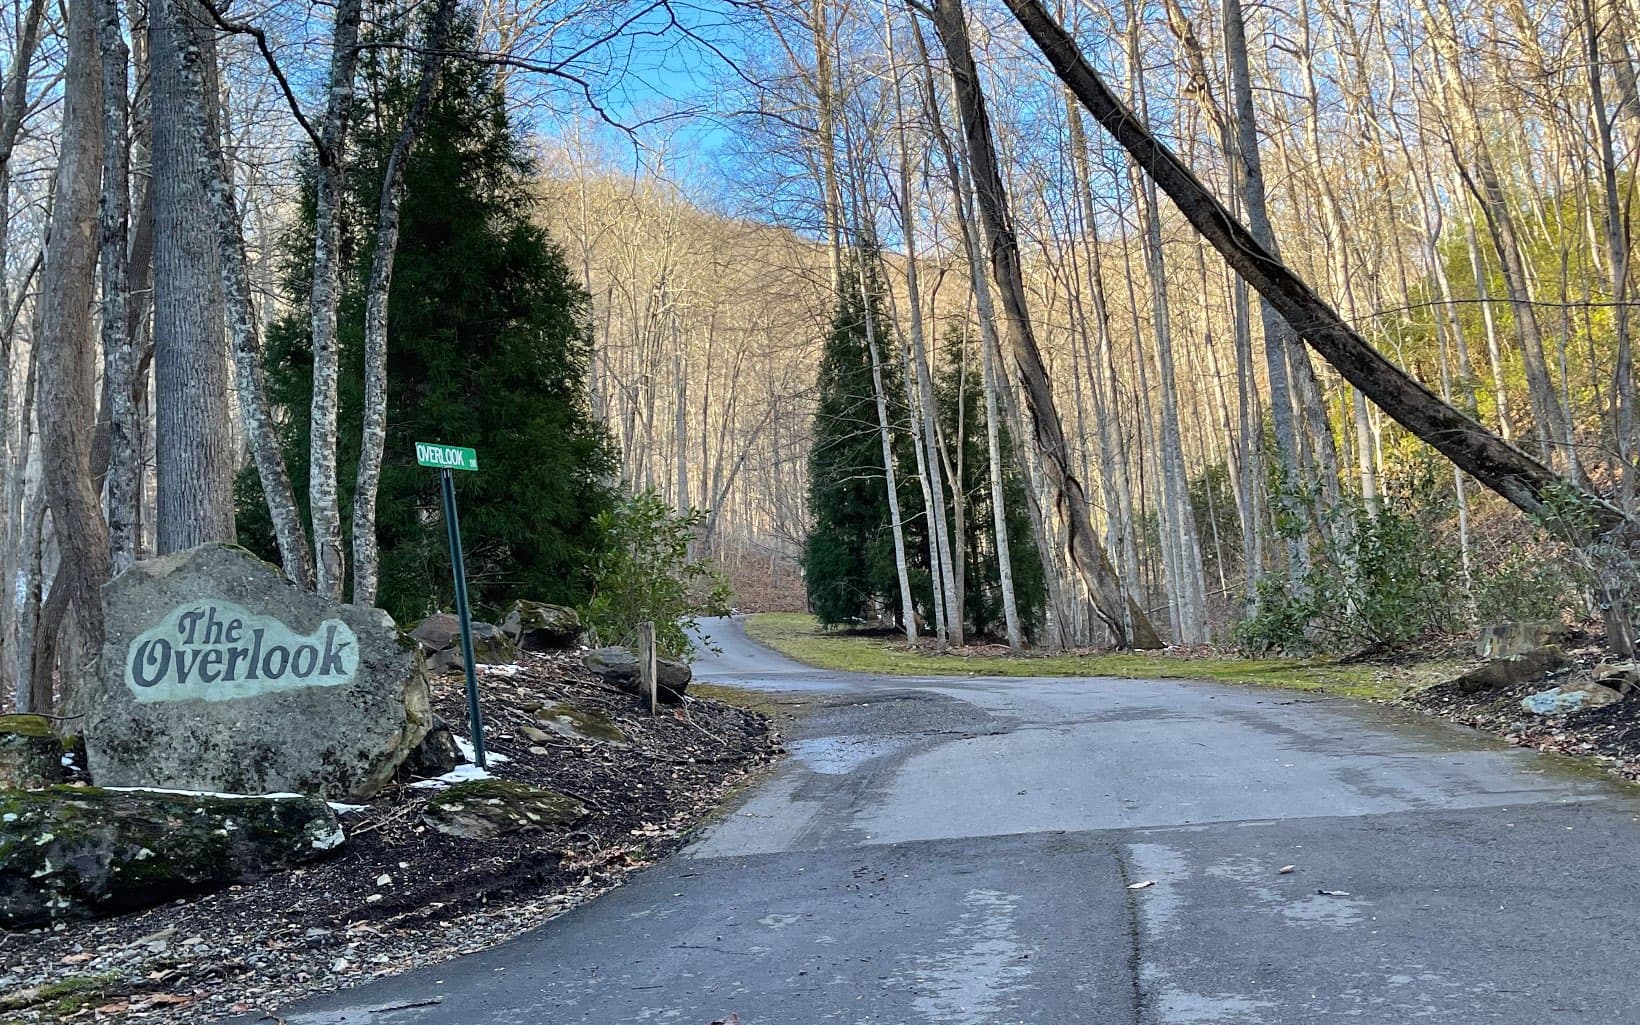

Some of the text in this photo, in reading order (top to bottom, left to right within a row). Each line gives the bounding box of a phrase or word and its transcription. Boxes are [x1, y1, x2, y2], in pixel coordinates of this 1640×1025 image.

[417, 445, 465, 466] OVERLOOK
[178, 606, 243, 646] The
[132, 625, 351, 687] Overlook
